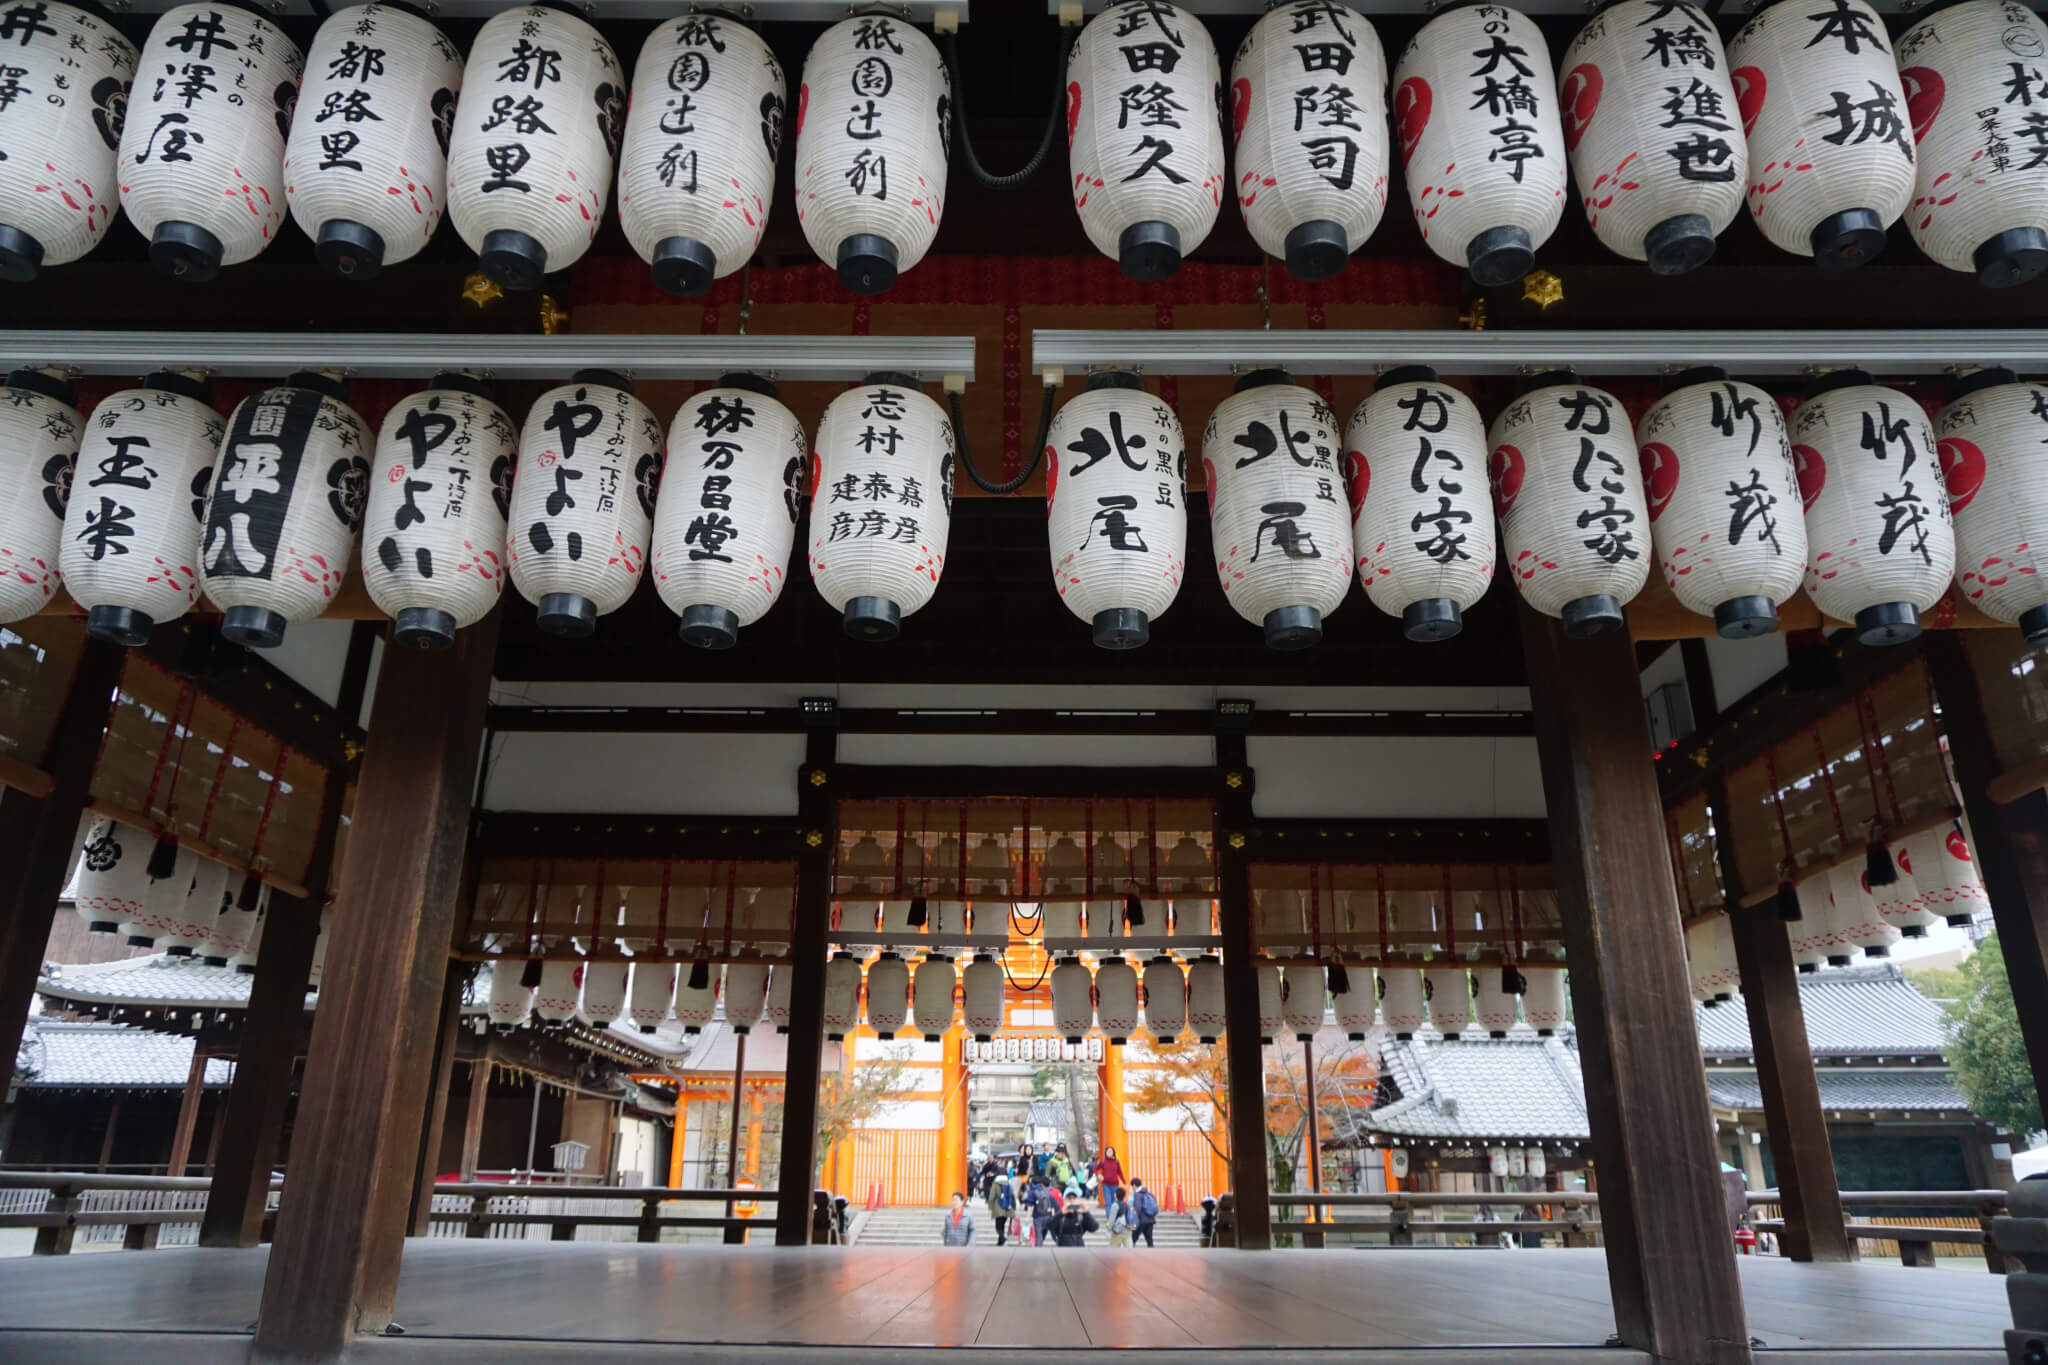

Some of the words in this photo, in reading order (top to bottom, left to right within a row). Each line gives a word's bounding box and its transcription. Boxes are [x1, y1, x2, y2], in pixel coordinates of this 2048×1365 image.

[135, 11, 238, 164] 井澤屋
[1114, 0, 1191, 185] 武田隆久
[1288, 0, 1366, 190] 武田隆司
[1636, 0, 1736, 182] 大橋進也
[1803, 0, 1914, 164] 本城
[378, 396, 457, 578] やよい
[528, 387, 603, 562] やよい
[684, 396, 756, 563] 林万昌堂
[855, 389, 906, 456] 志村
[1067, 411, 1149, 552] 北尾
[1233, 409, 1322, 562] 北尾
[1397, 387, 1473, 563] かに家
[1558, 390, 1640, 564] かに家
